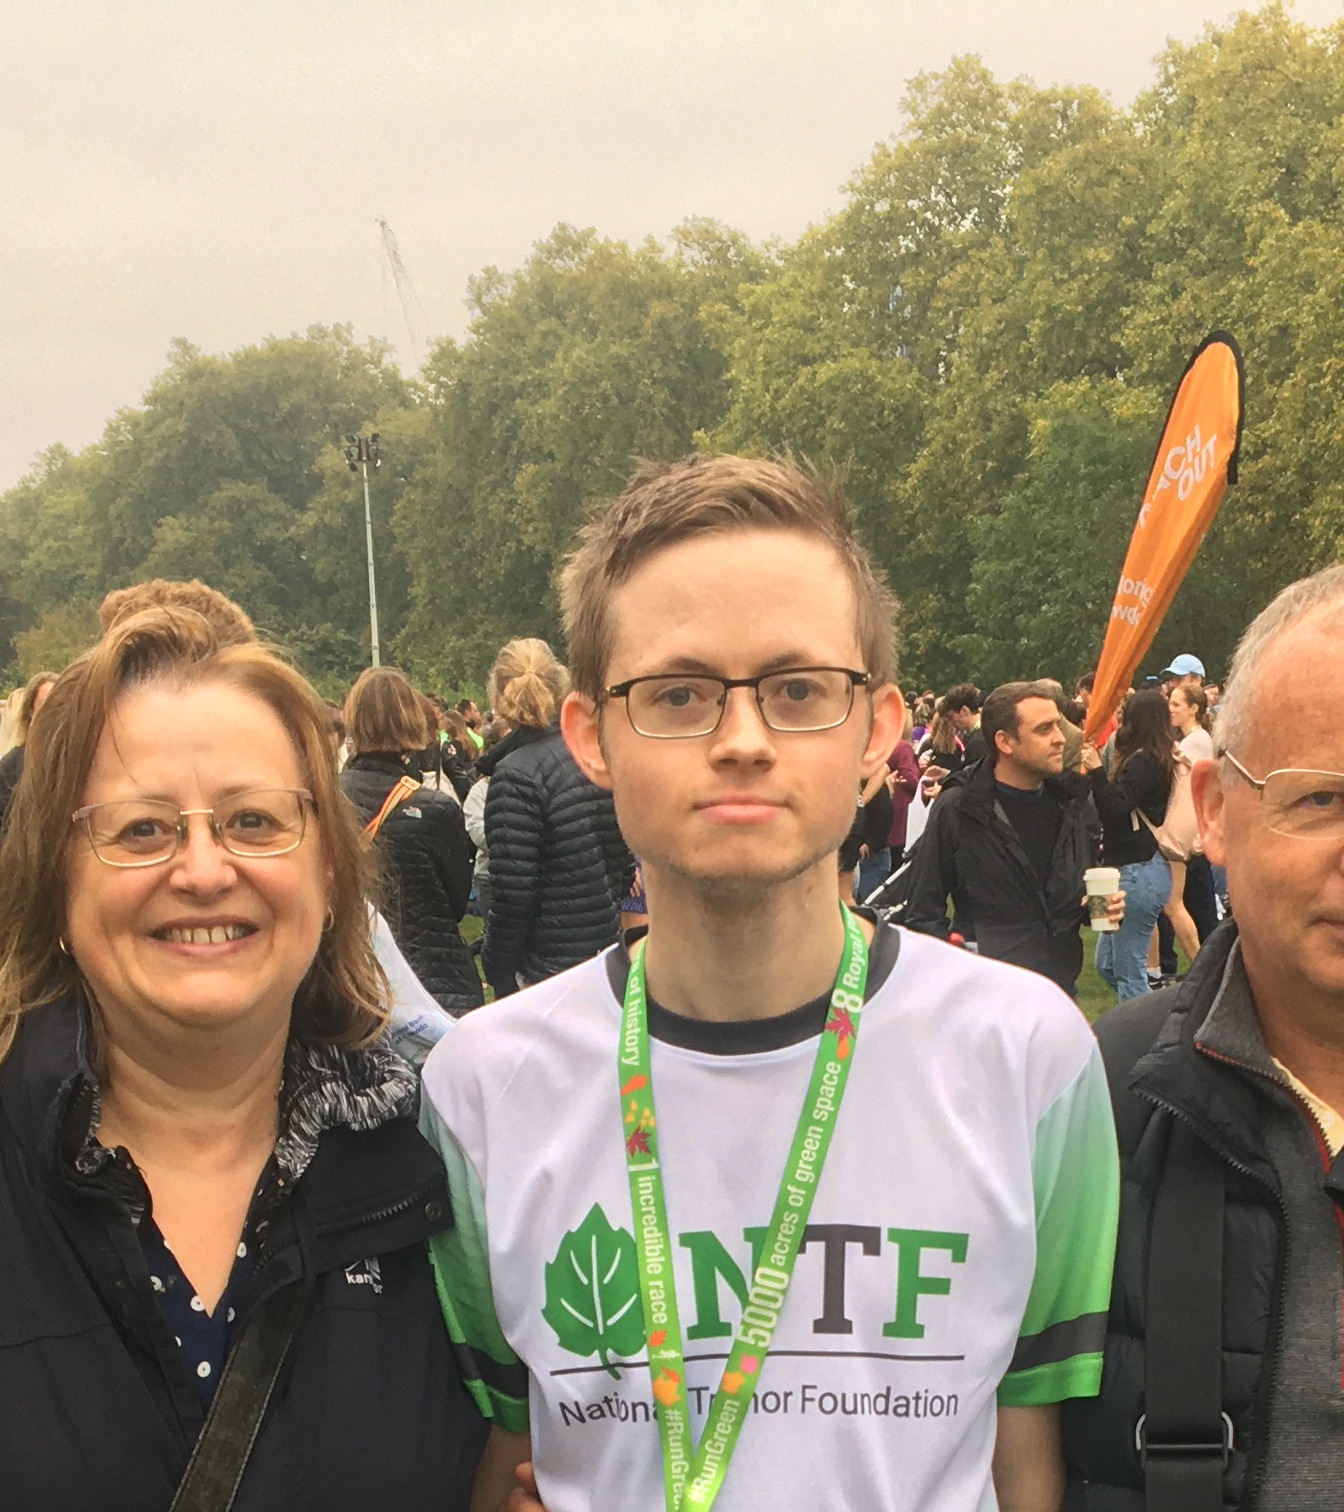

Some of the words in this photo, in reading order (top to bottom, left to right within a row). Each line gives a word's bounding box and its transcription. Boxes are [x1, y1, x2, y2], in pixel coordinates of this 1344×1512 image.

[1176, 433, 1218, 501] OUT
[842, 932, 866, 989] Royal
[831, 988, 864, 1013] 8
[621, 998, 643, 1066] history
[813, 1061, 842, 1122] space
[628, 1158, 659, 1172] 1
[795, 1125, 824, 1184] green
[638, 1176, 666, 1275] incredible
[787, 1185, 806, 1208] of
[770, 1211, 799, 1267] acres
[648, 1280, 668, 1324] race
[678, 1224, 969, 1341] NTF
[736, 1267, 790, 1349] 5000
[800, 1384, 959, 1418] Foundation
[688, 1399, 740, 1504] #RunGreen
